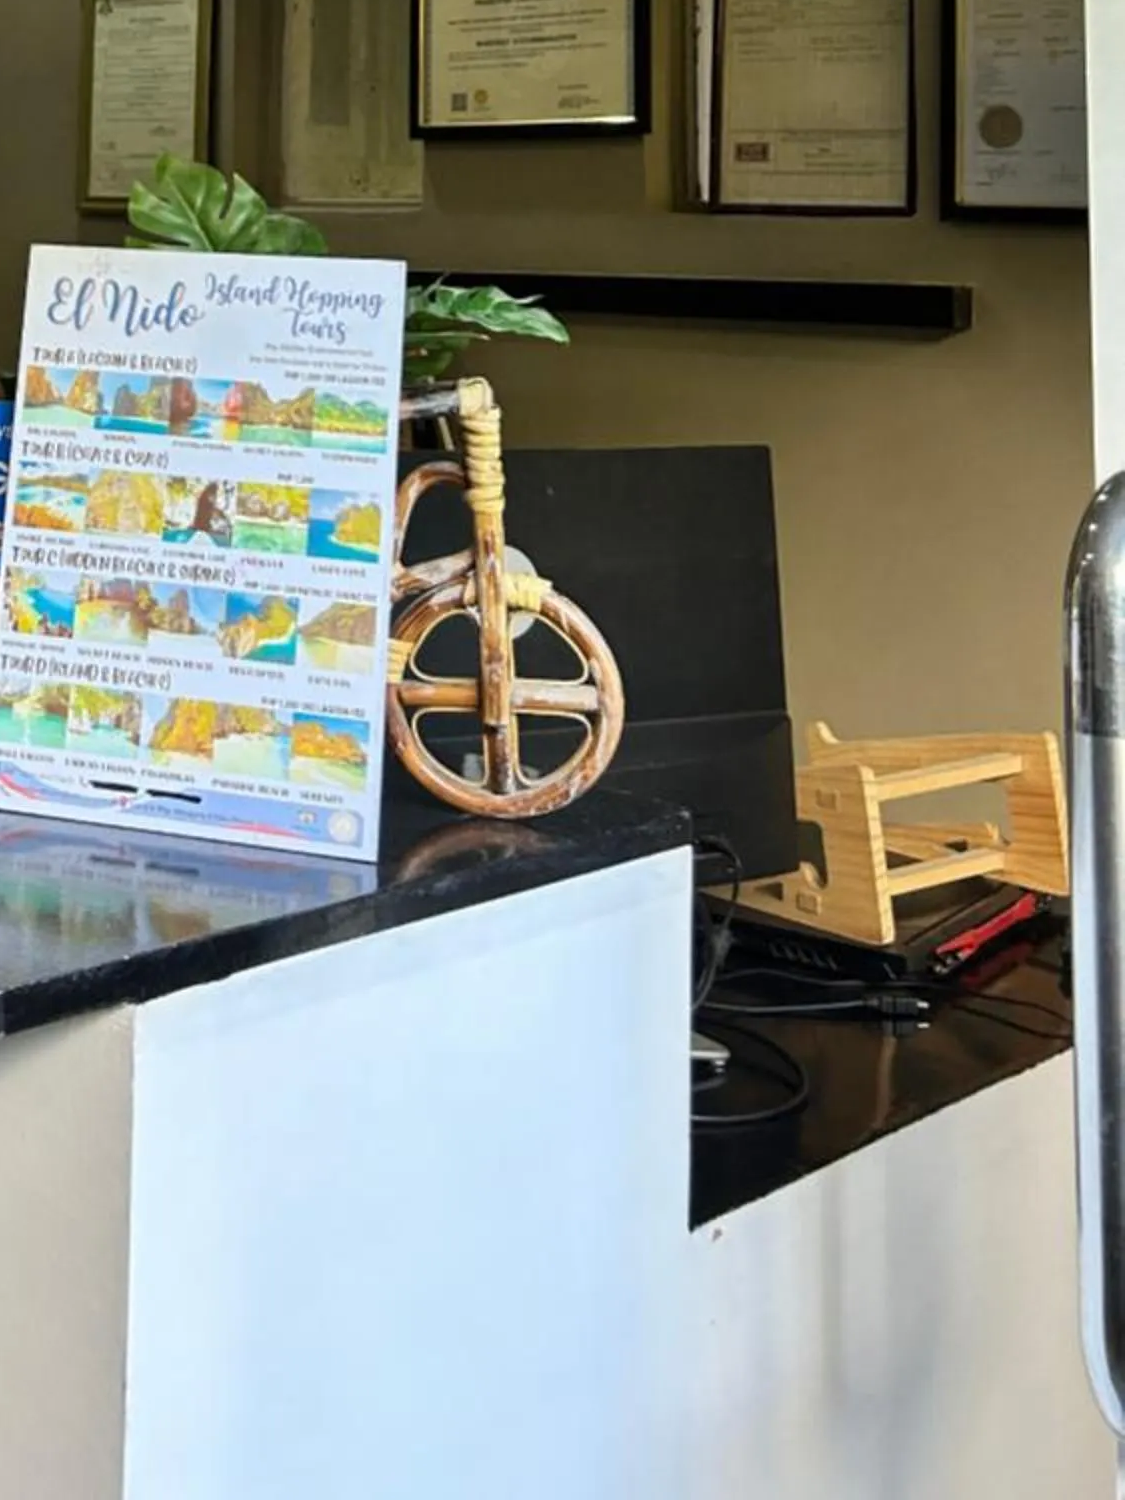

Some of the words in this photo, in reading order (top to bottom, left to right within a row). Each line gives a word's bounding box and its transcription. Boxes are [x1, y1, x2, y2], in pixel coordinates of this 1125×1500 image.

[47, 276, 96, 332] El
[102, 279, 206, 337] Nido
[205, 272, 282, 306] Island
[284, 276, 385, 319] Hopping
[283, 307, 347, 343] Tours
